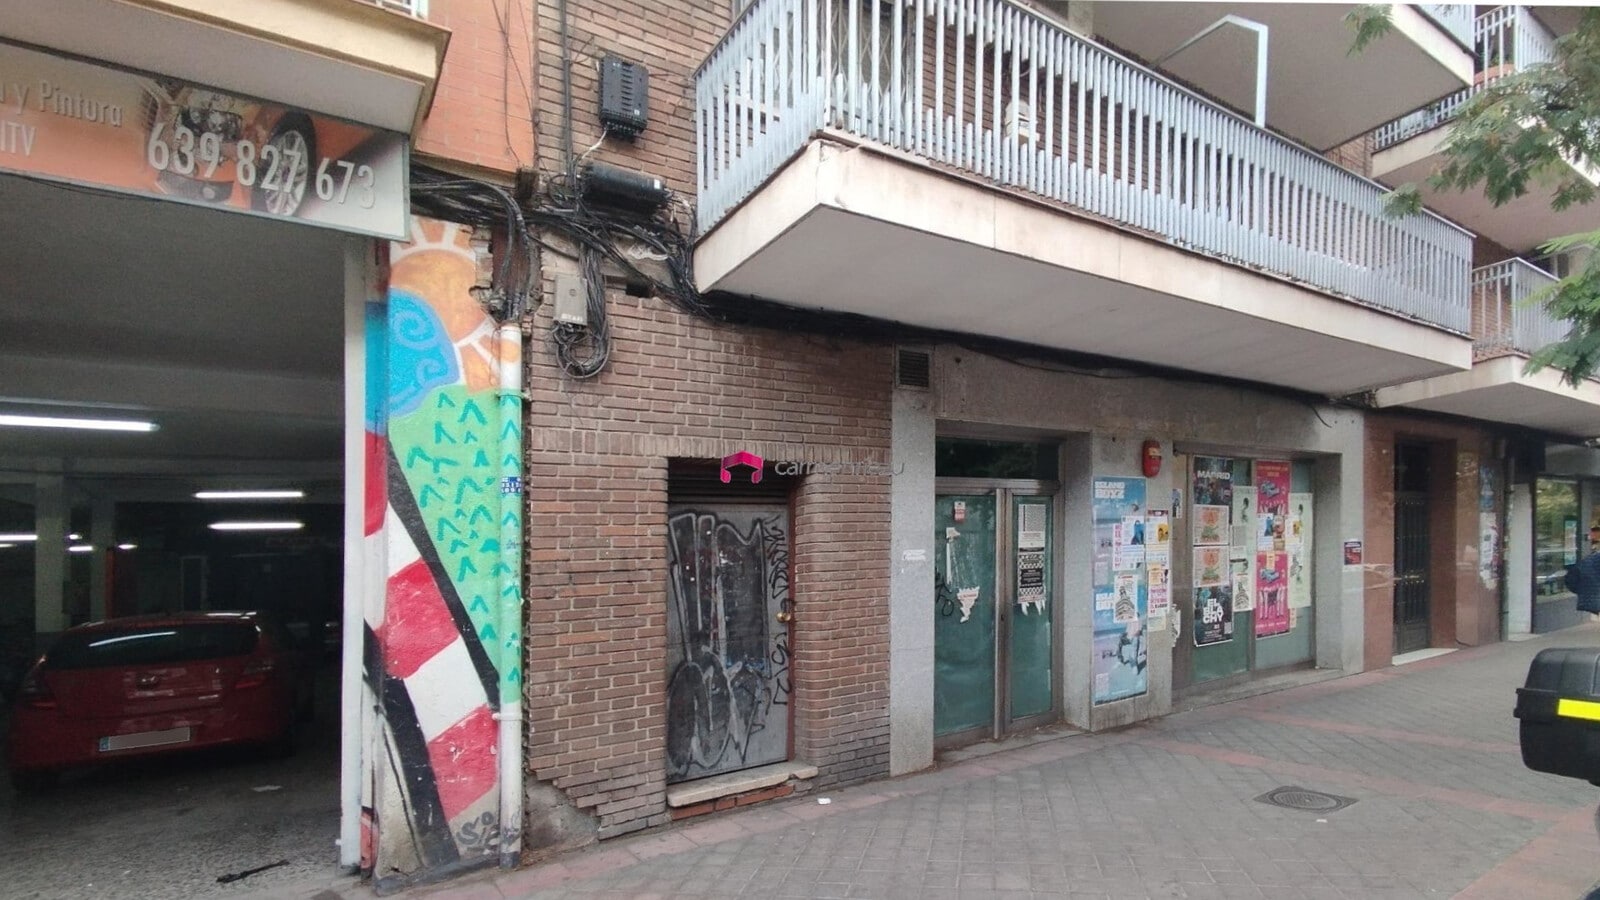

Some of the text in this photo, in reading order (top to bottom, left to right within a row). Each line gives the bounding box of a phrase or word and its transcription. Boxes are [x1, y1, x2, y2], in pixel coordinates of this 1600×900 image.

[13, 82, 30, 116] y
[39, 79, 123, 128] Pintura
[147, 122, 376, 210] 639 827 673
